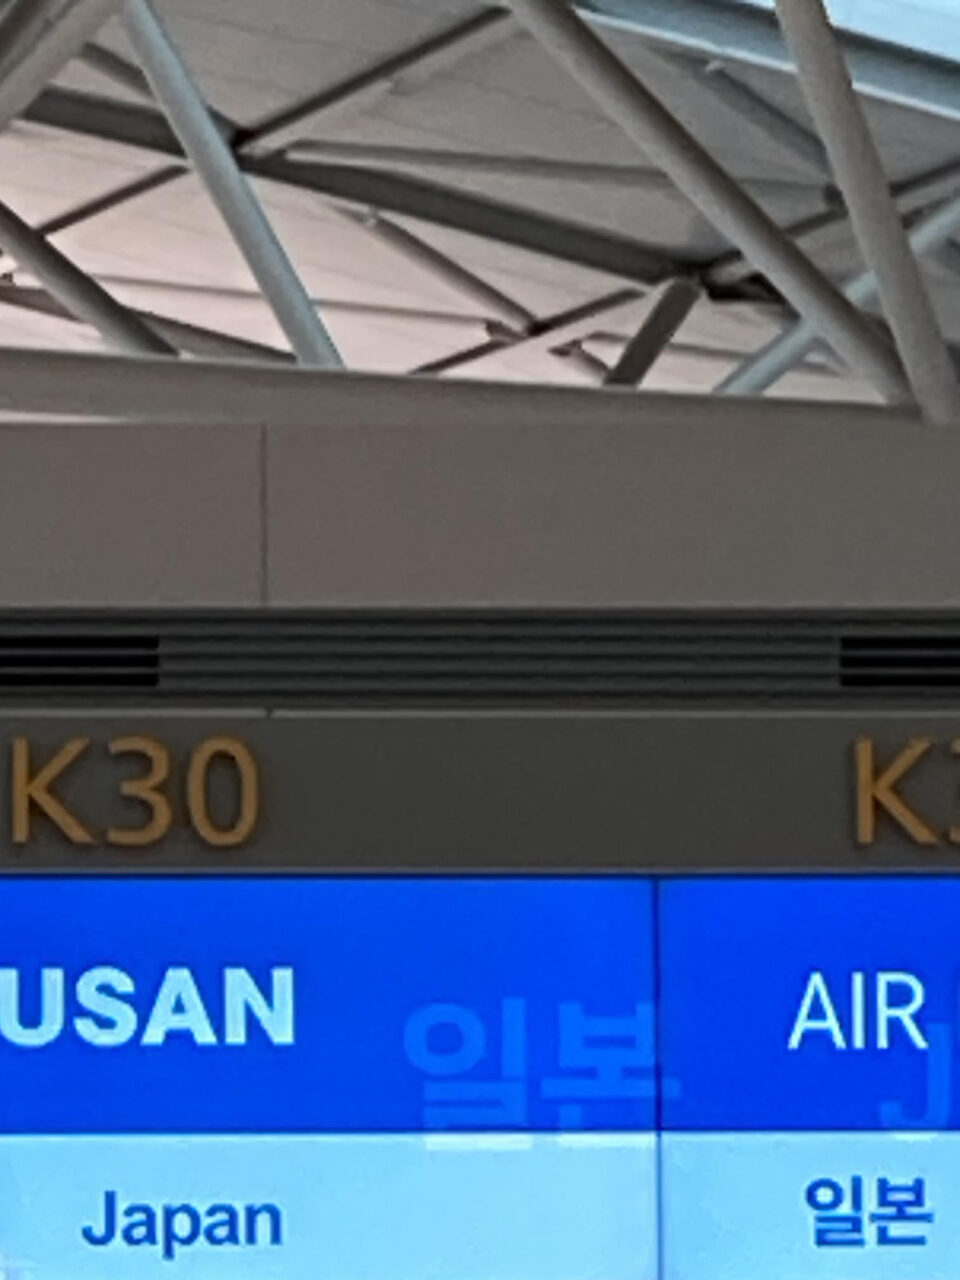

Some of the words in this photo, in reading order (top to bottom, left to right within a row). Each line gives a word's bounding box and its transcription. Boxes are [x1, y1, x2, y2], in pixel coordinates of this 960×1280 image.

[12, 736, 260, 846] K30
[853, 736, 960, 846] K
[787, 970, 931, 1051] AIR
[81, 1190, 284, 1260] Japan
[804, 1175, 935, 1248] 일본
